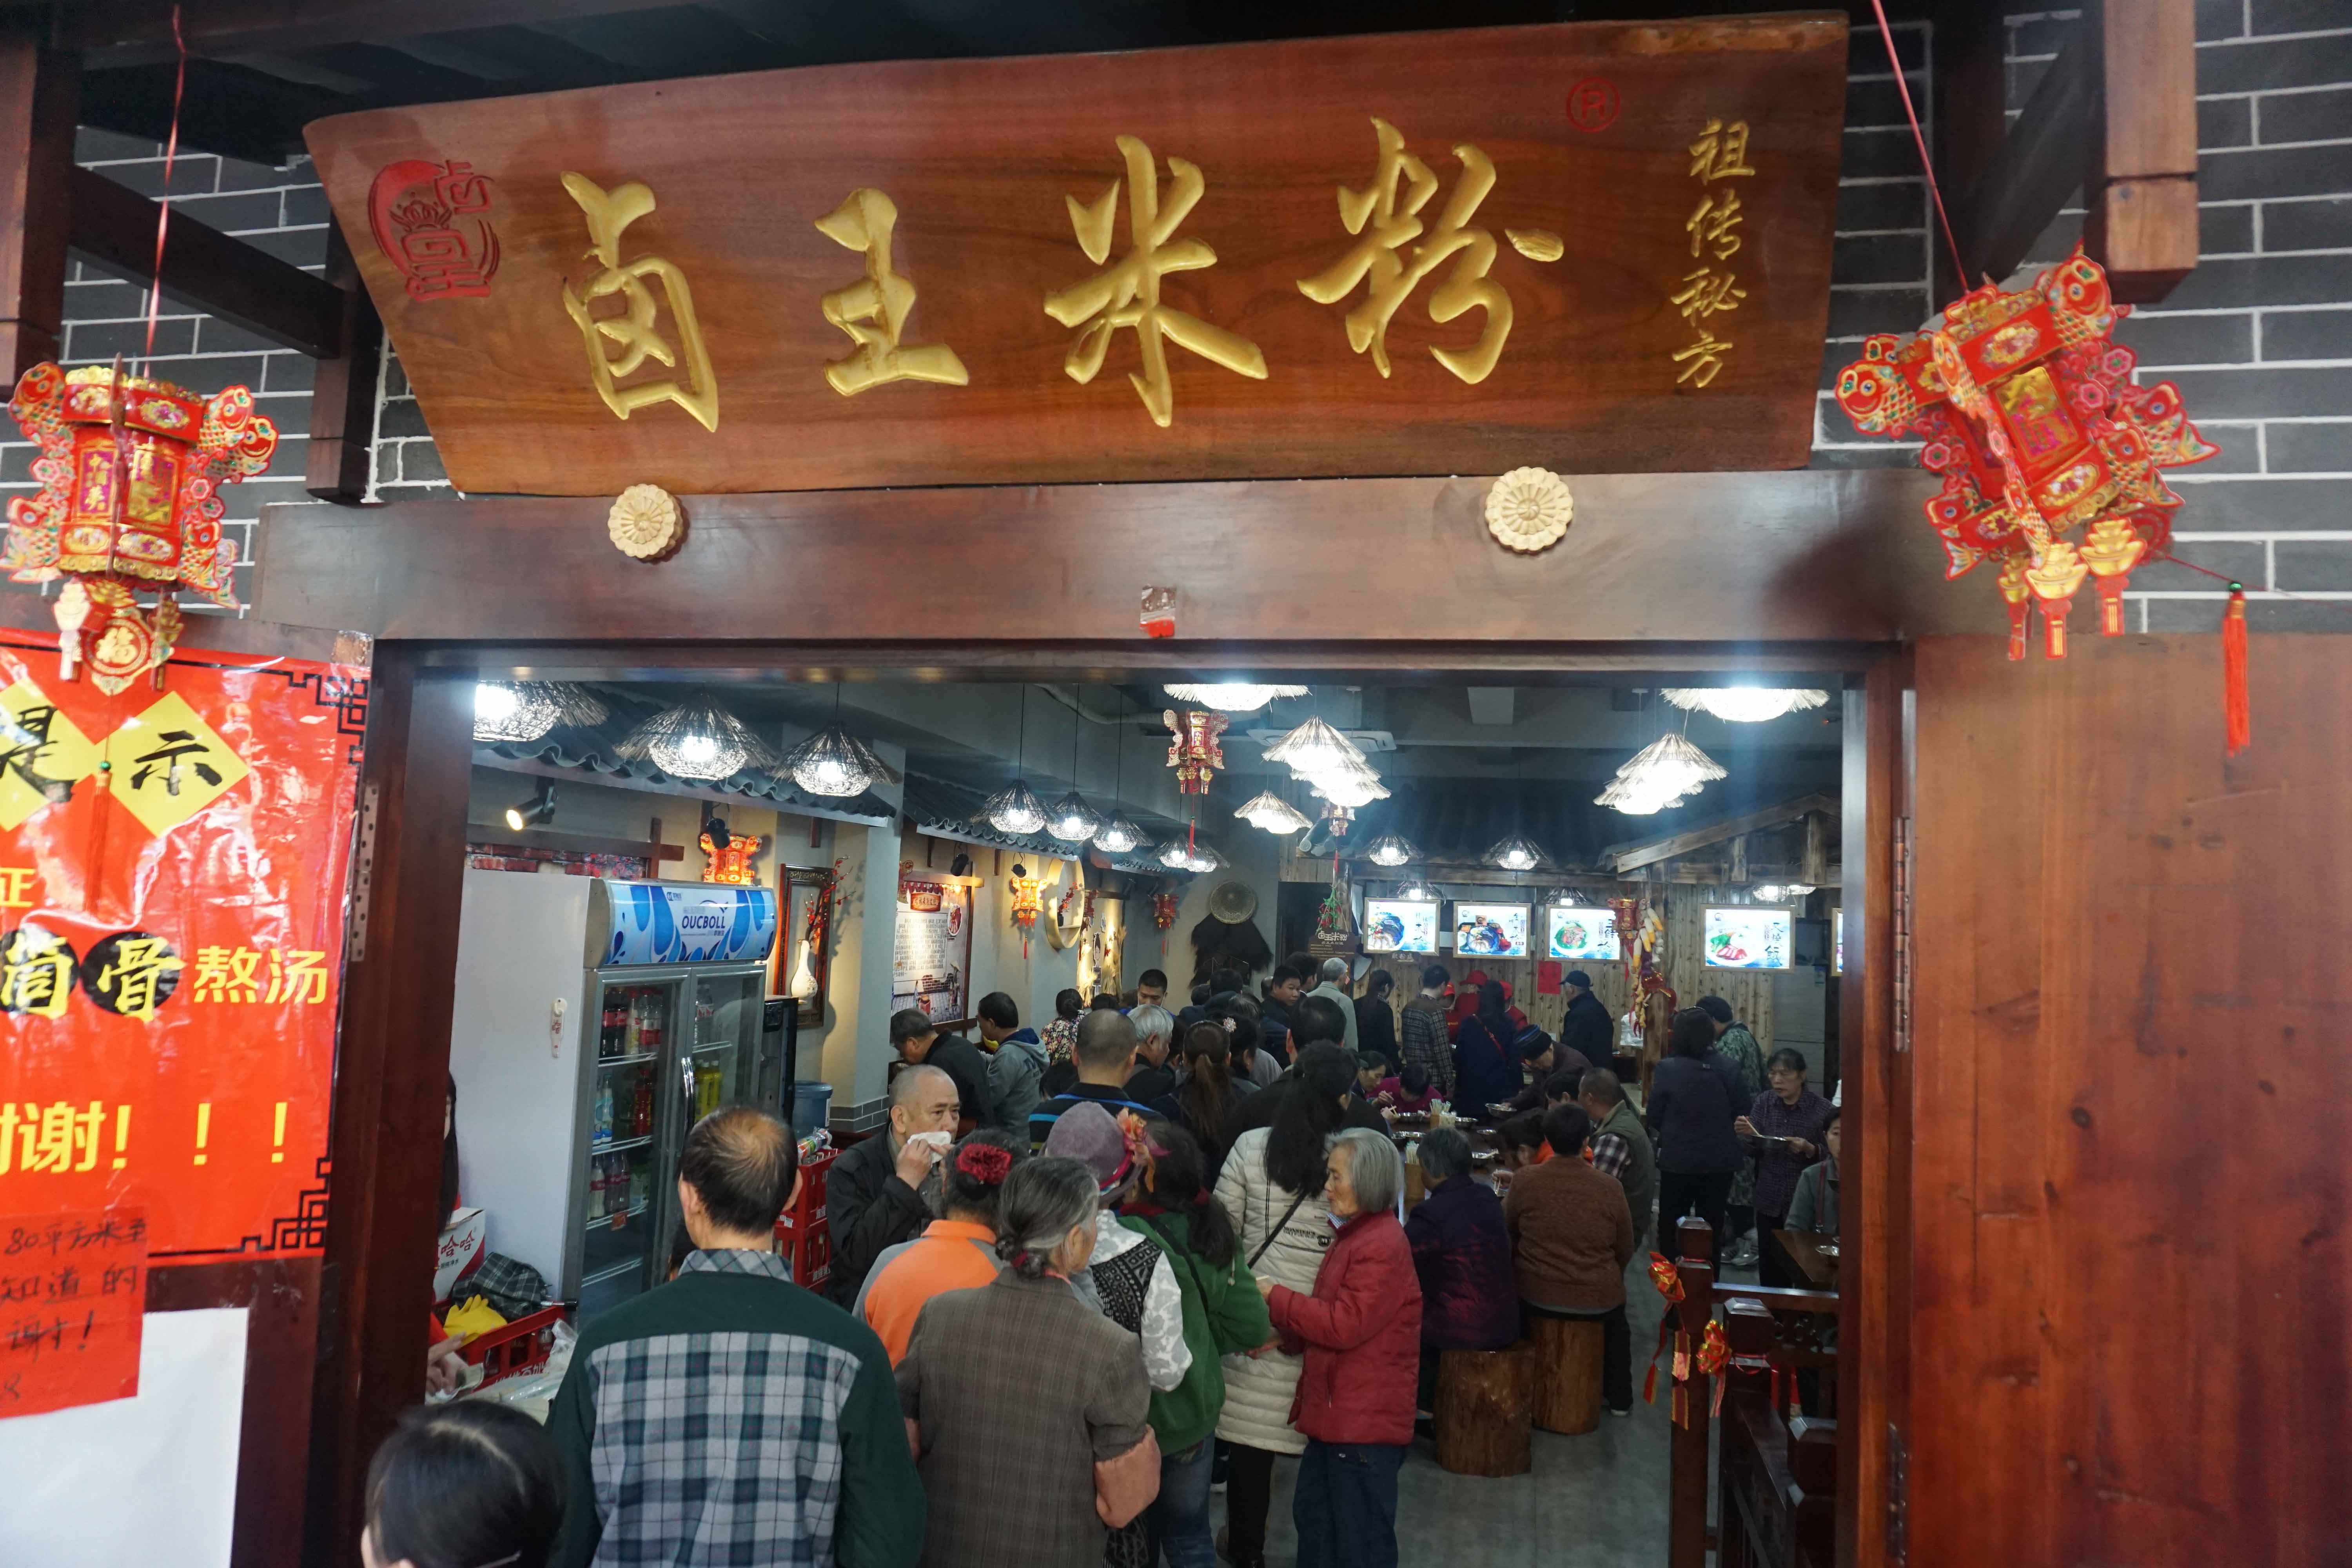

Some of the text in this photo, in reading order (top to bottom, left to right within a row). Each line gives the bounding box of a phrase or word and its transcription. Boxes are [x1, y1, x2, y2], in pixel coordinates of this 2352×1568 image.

[561, 117, 1564, 432] 卤王米粉
[1671, 118, 1756, 389] 祖传秘方
[682, 916, 725, 929] OUCBOLL
[438, 1229, 475, 1258] 哈哈
